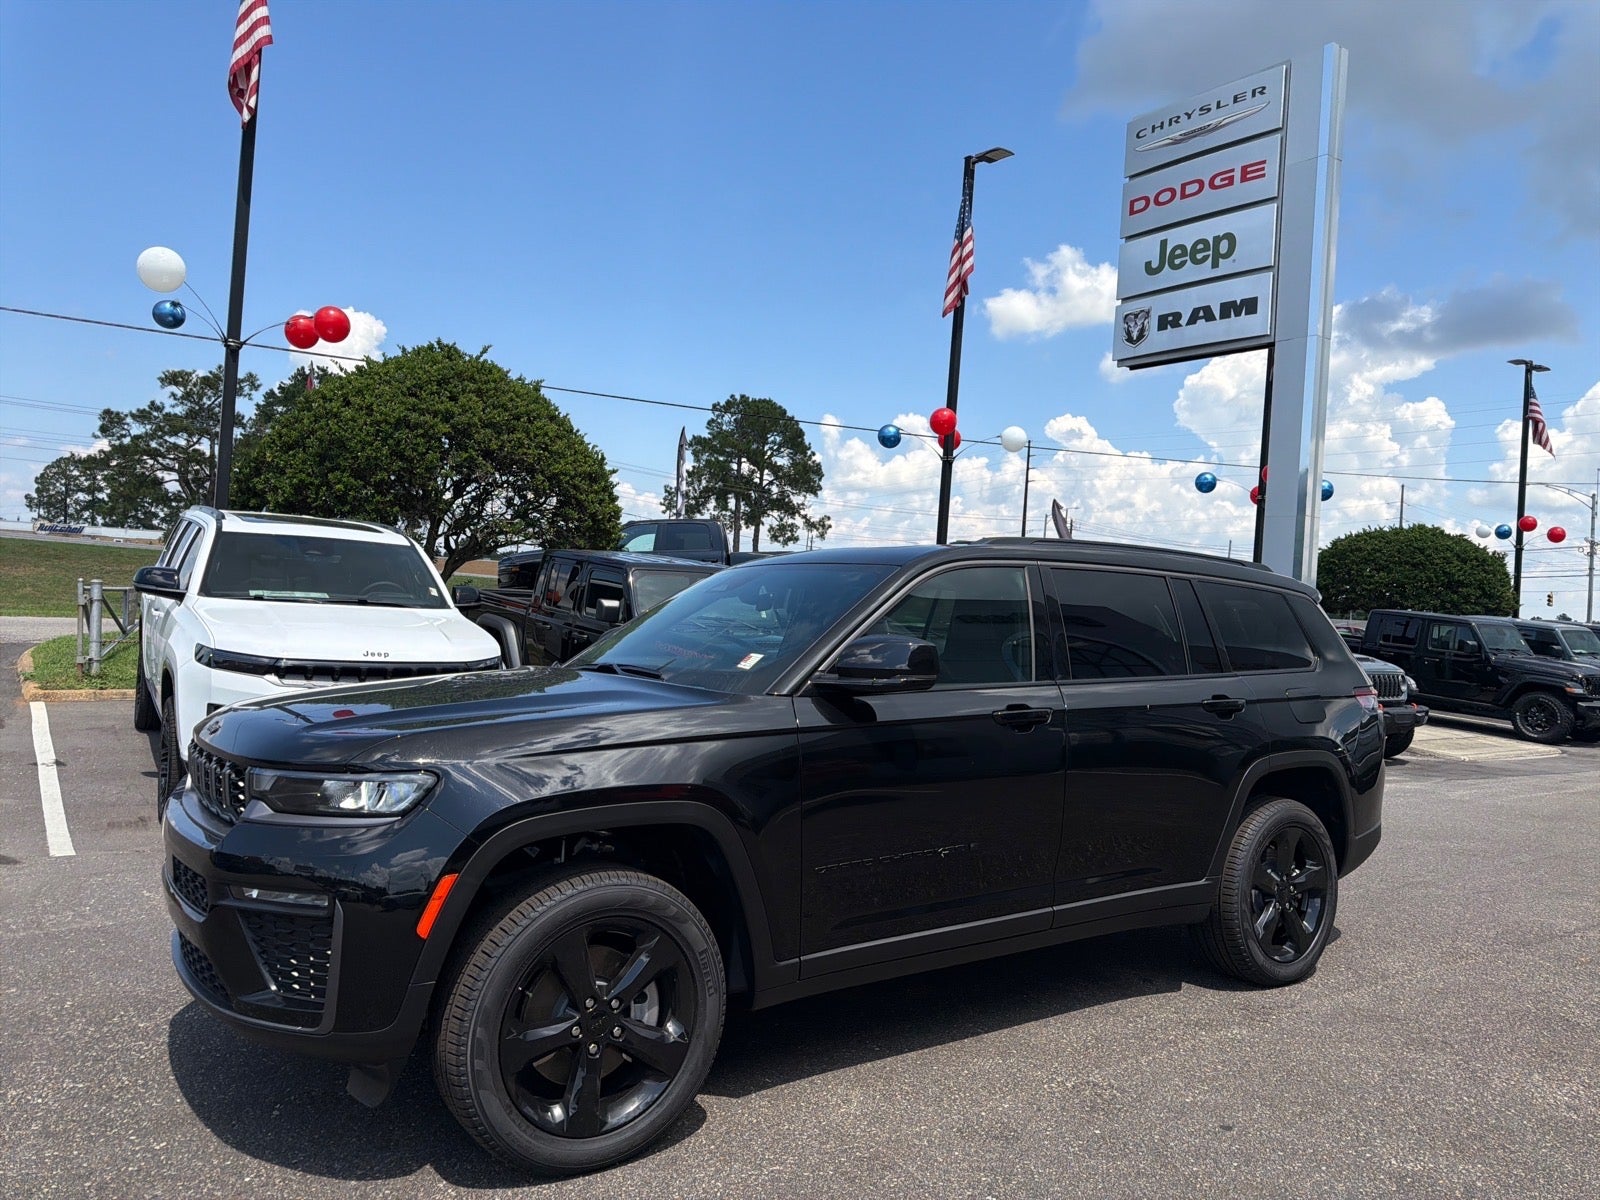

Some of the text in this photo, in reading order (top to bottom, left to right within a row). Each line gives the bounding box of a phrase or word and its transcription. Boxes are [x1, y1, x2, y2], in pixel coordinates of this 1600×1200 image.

[1135, 85, 1267, 139] CHRYSLER
[1128, 159, 1267, 216] DODGE
[1144, 231, 1237, 276] Jeep
[1156, 296, 1259, 332] RAM
[362, 650, 389, 658] Jeep
